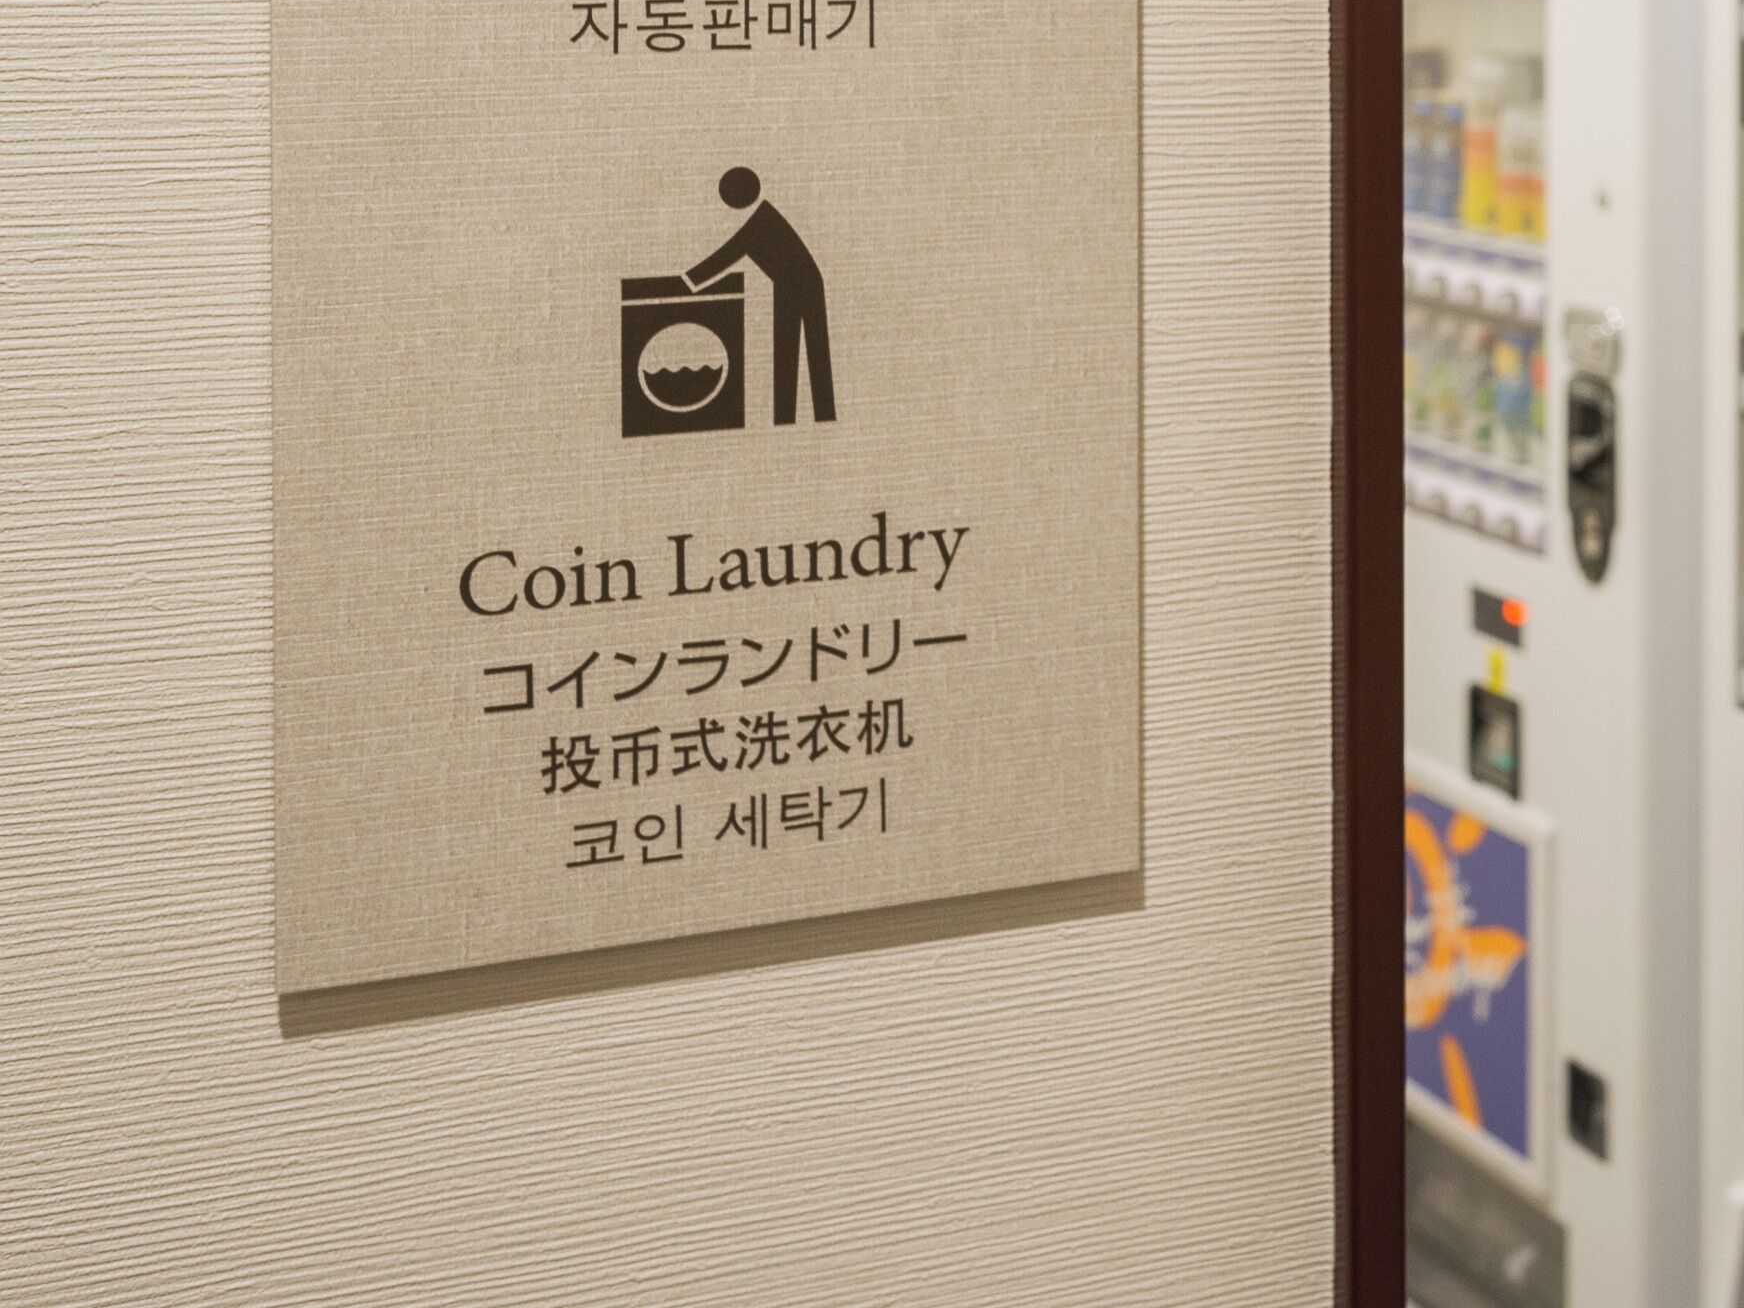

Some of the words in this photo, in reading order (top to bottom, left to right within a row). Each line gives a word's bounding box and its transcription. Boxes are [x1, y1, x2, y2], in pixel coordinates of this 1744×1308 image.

[459, 546, 642, 616] Coin
[667, 511, 970, 596] Laundry
[483, 618, 968, 714] コインランドリー
[540, 698, 915, 794] 投币式洗衣机
[565, 804, 684, 869] 코인
[714, 778, 888, 850] 세탁기
